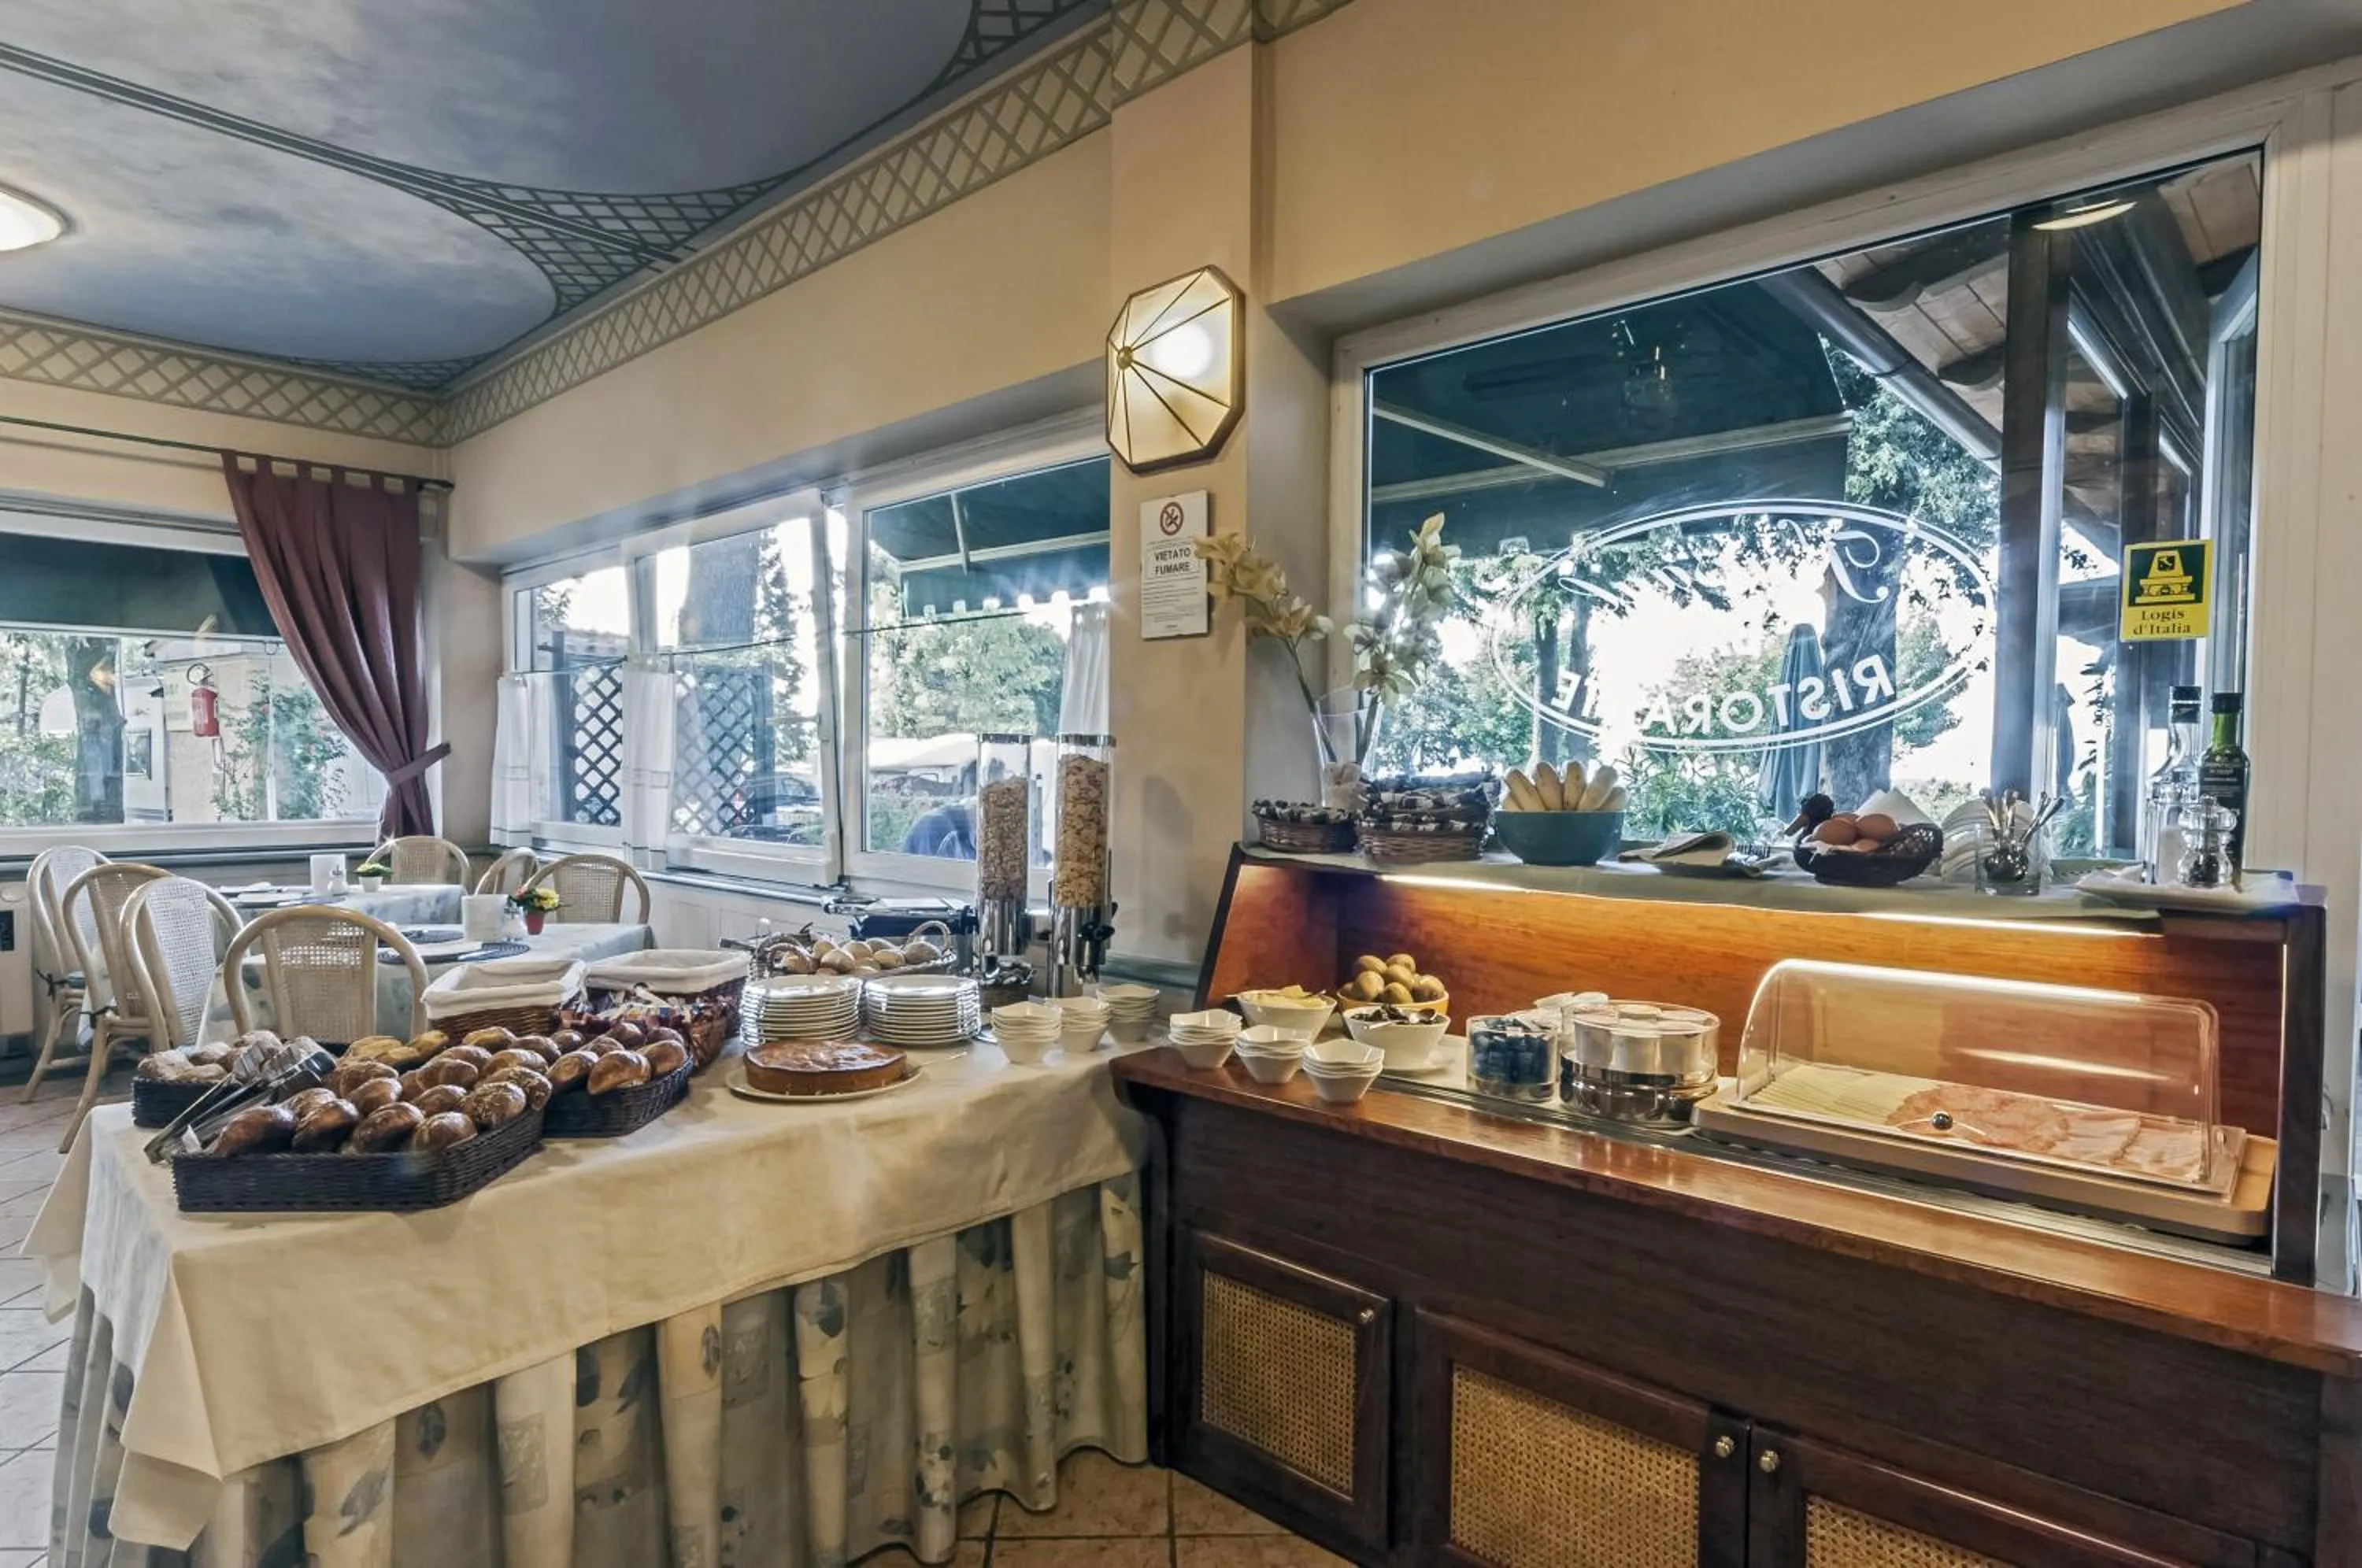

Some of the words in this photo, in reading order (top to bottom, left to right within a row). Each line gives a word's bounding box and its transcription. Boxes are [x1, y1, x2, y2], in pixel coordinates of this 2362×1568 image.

[1153, 547, 1190, 561] VIETATO
[1155, 561, 1190, 574] FUMARE
[2142, 609, 2184, 622] Logis
[2133, 623, 2191, 635] d'Italia
